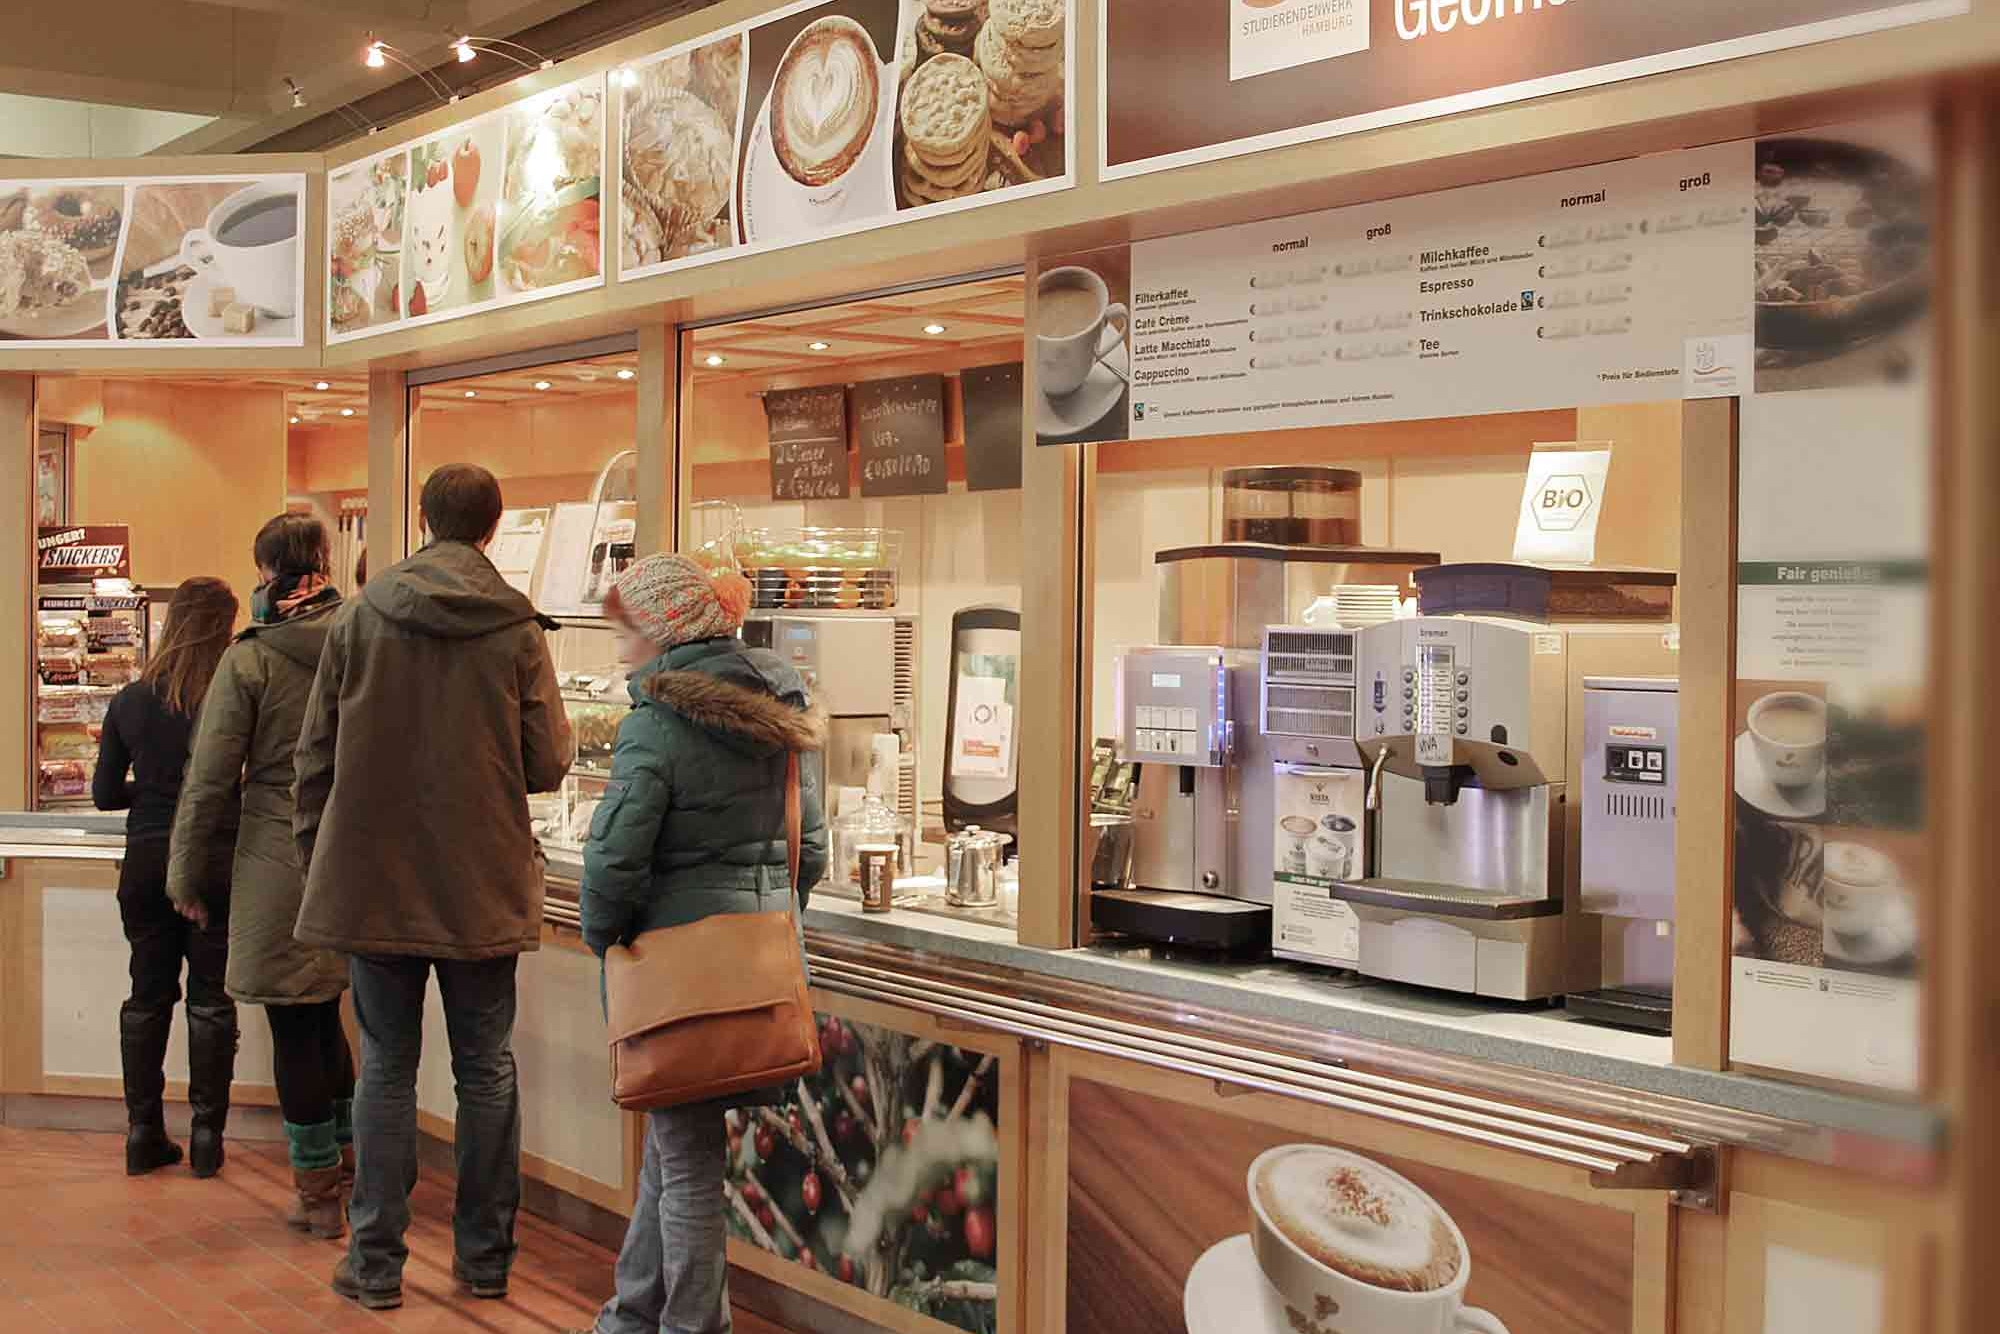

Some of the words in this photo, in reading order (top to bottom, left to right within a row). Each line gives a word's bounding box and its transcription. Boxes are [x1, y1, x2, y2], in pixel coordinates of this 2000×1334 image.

[1302, 14, 1353, 37] HAMBURG
[1679, 172, 1711, 191] groß
[1560, 189, 1606, 208] normal
[1366, 223, 1392, 240] groß
[1272, 236, 1309, 252] normal
[1420, 246, 1489, 265] Milchkaffee
[1420, 278, 1474, 294] Espresso
[1135, 289, 1189, 304] Filterkaffee
[1420, 300, 1518, 322] Trinkschokolade
[1135, 343, 1159, 355] Latte
[1161, 338, 1211, 352] Macchiato
[1420, 339, 1440, 351] Tee
[1134, 367, 1190, 384] Cappuccino
[45, 547, 121, 566] SNICKERS
[1777, 566, 1807, 581] Fair
